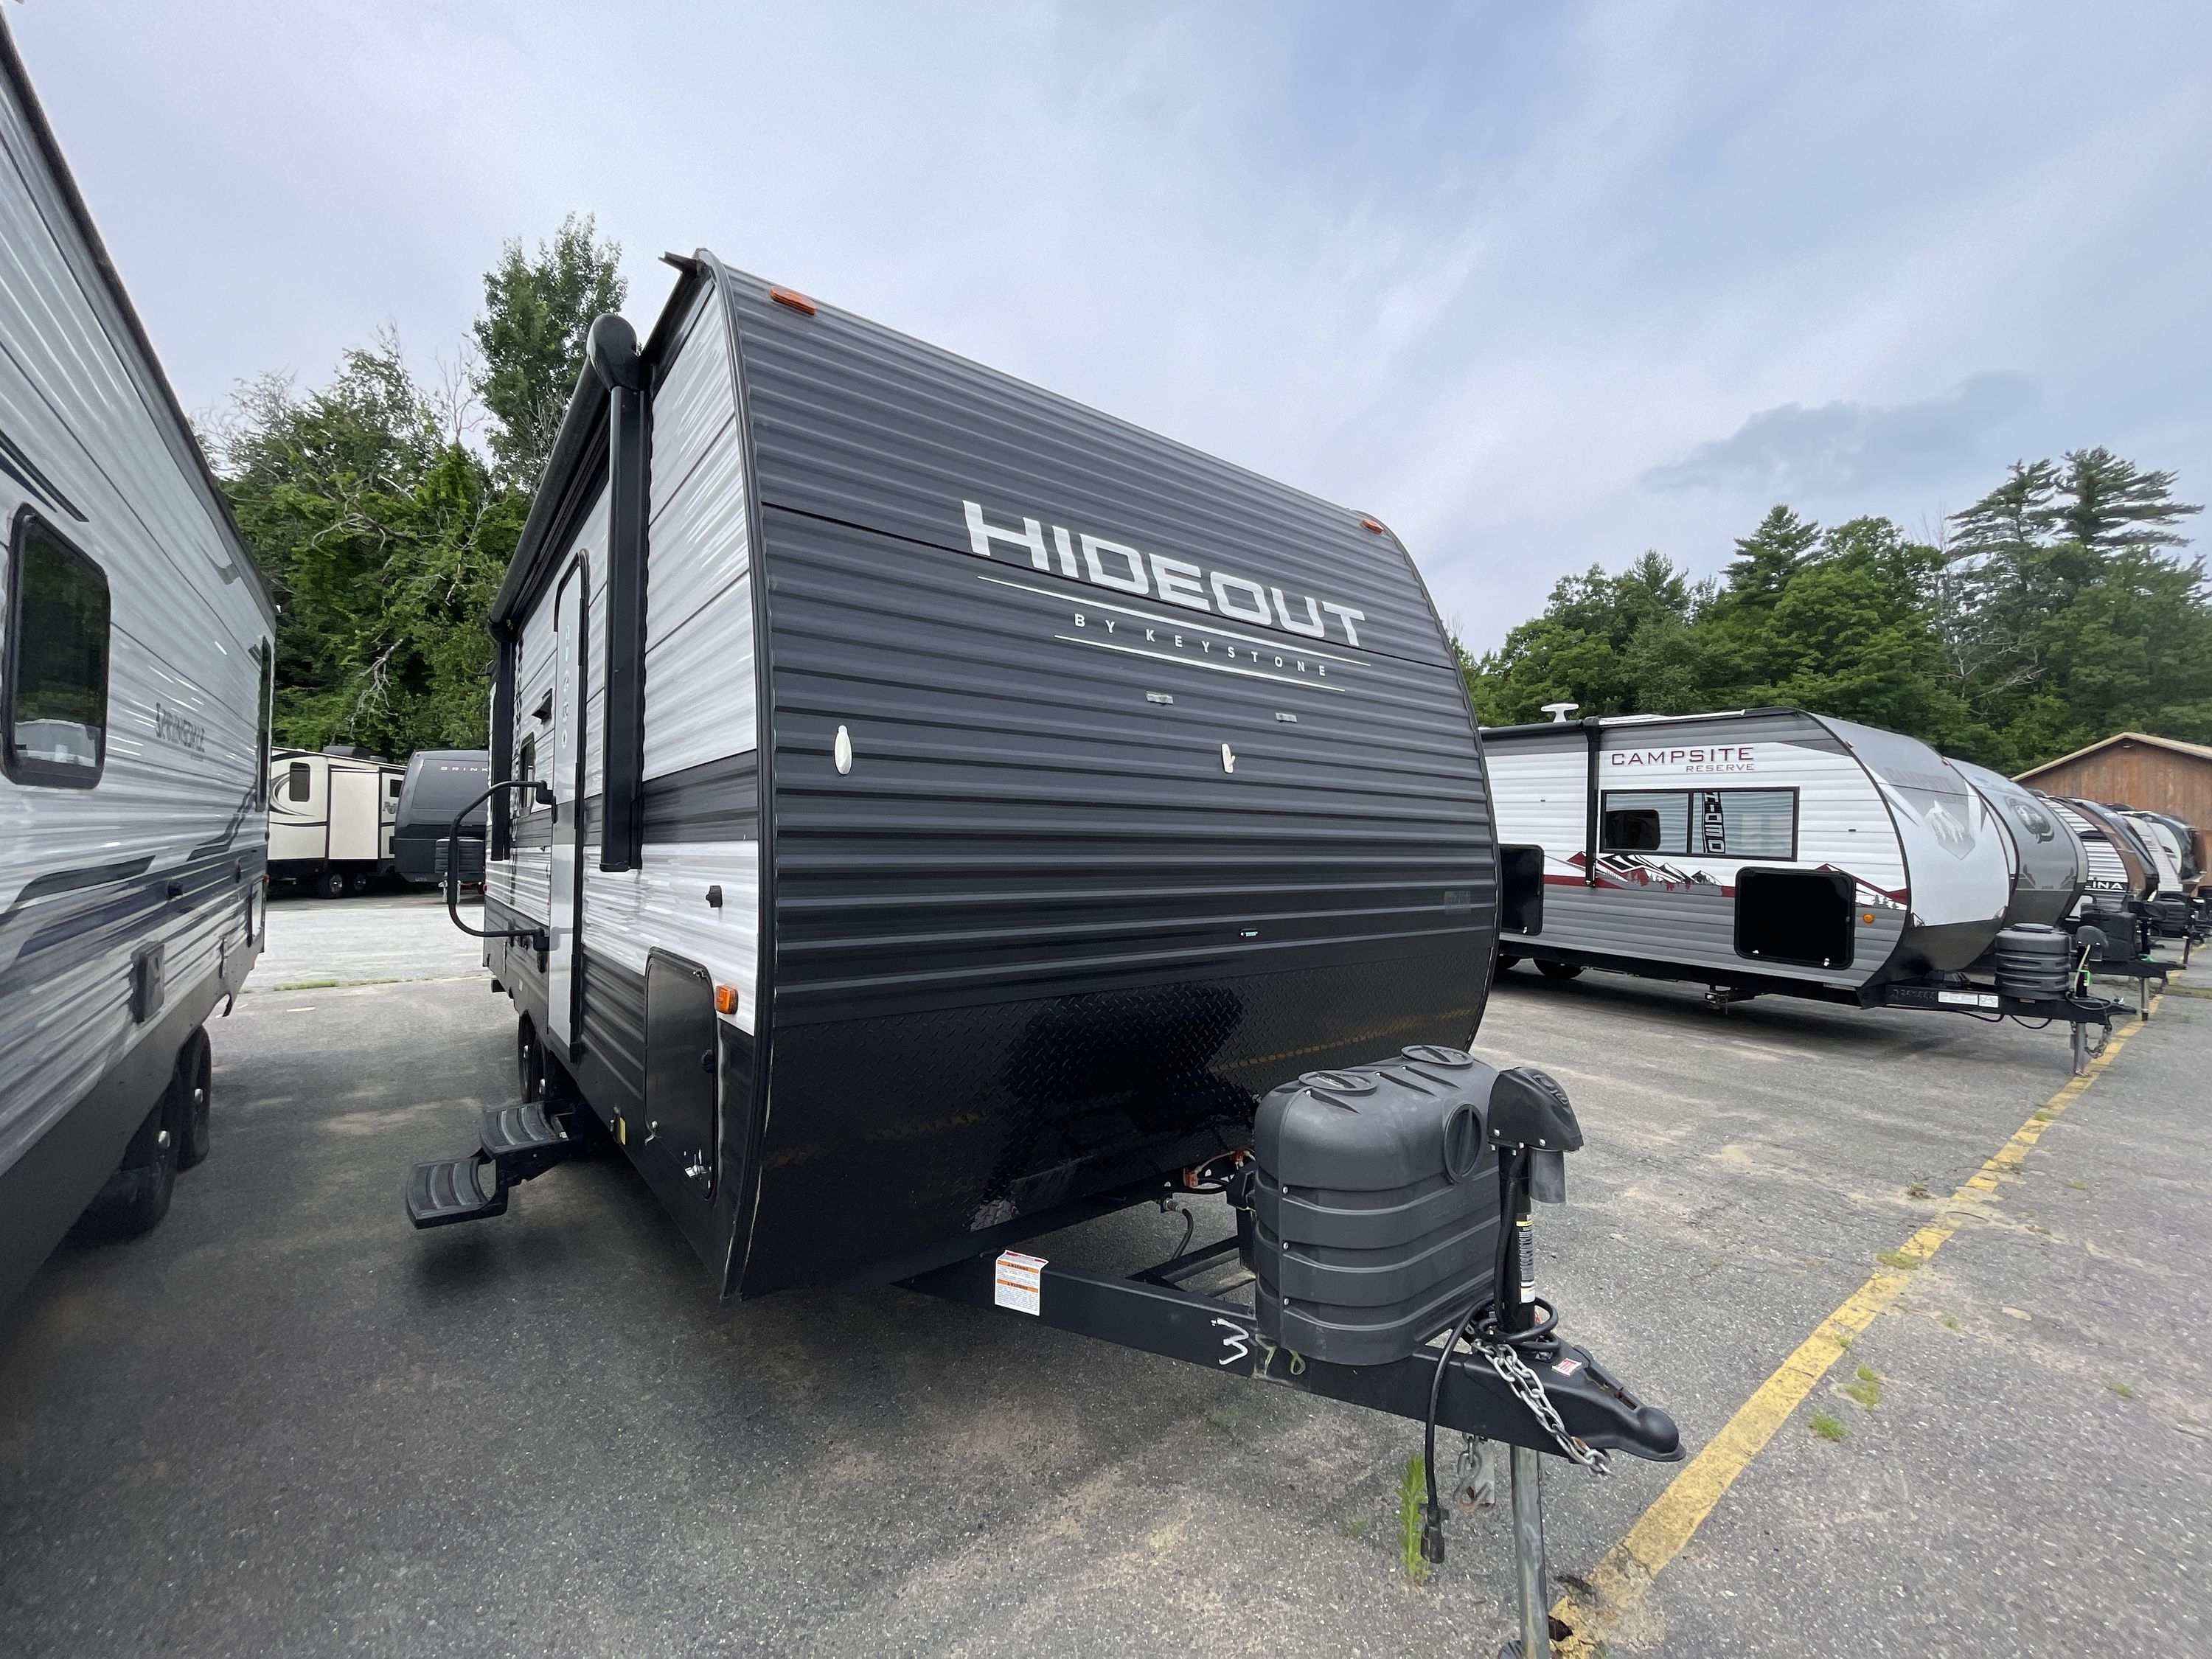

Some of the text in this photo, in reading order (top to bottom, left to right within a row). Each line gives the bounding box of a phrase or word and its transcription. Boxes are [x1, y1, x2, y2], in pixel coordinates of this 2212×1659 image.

[962, 500, 1365, 647] HIDEOUT
[1074, 613, 1326, 677] BY KEYSTONE
[1611, 747, 1754, 766] CAMPSITE
[1686, 763, 1756, 773] RESERVE
[2085, 880, 2124, 890] INA
